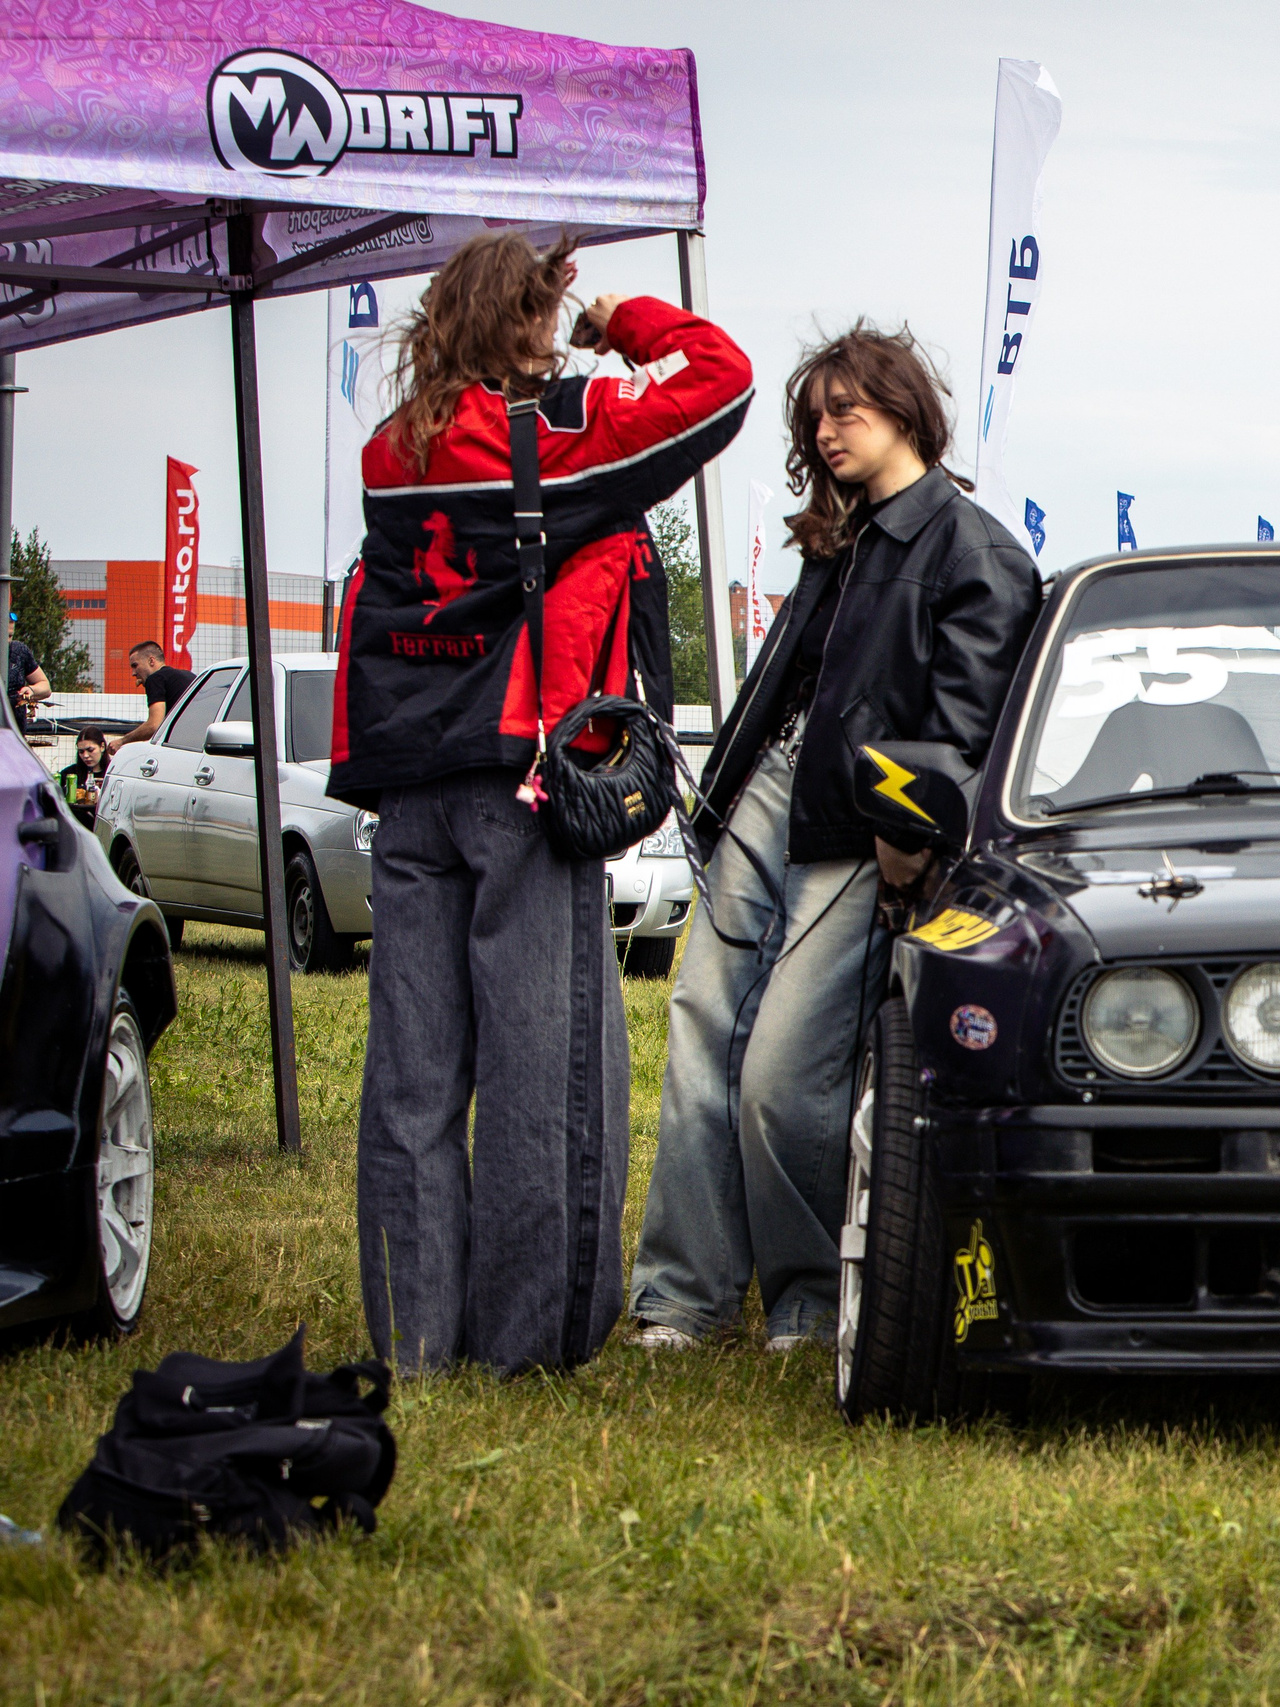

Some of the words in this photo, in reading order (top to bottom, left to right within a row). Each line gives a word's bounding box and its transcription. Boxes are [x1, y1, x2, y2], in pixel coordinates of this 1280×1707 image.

[343, 91, 520, 156] DRIFT
[997, 234, 1040, 376] ВТБ
[172, 489, 196, 653] auto.ru
[389, 632, 488, 658] Ferrari
[1058, 627, 1229, 718] 55
